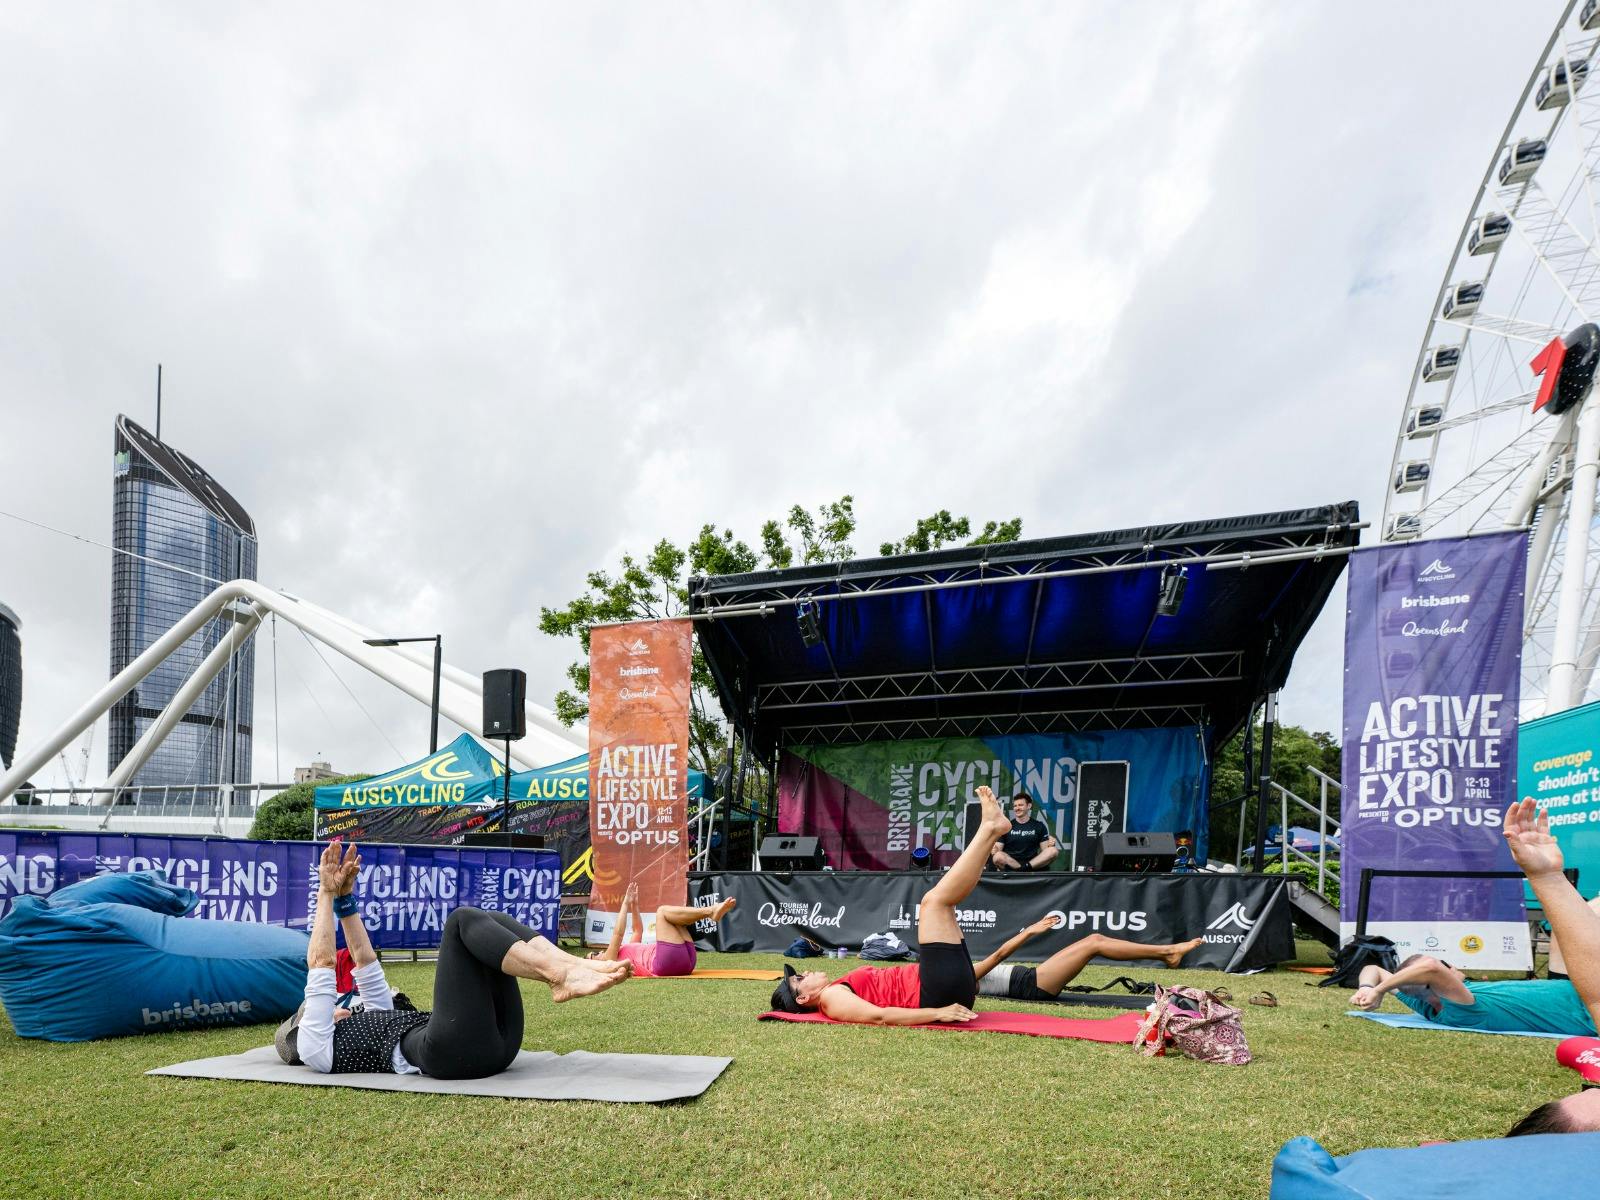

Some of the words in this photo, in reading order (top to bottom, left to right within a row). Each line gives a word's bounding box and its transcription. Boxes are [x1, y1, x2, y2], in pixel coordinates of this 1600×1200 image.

[1401, 594, 1471, 608] brisbane
[1401, 619, 1469, 637] Queensland
[620, 666, 659, 676] brisbane
[1361, 694, 1503, 743] ACTIVE
[597, 743, 678, 778] ACTIVE
[1360, 738, 1501, 774] LIFESTYLE
[1533, 750, 1593, 772] coverage
[526, 778, 587, 798] AUSC
[597, 777, 678, 802] LIFESTYLE
[918, 757, 1077, 806] CYCLING
[1359, 768, 1453, 810] EXPO
[1464, 777, 1490, 788] 12-13
[1537, 767, 1600, 791] shouldn't
[341, 782, 465, 806] AUSCYCLING
[1464, 788, 1492, 799] APRIL
[1536, 795, 1570, 809] come
[1572, 789, 1588, 804] at
[419, 805, 442, 817] TRACK
[597, 802, 649, 830] EXPO
[887, 763, 914, 851] BRISBANE
[1088, 800, 1099, 819] Red
[1395, 807, 1502, 828] OPTUS
[466, 815, 484, 828] MTB
[656, 815, 674, 823] APRIL
[1087, 819, 1098, 837] Bull
[1546, 811, 1587, 827] pense
[615, 830, 680, 845] OPTUS
[357, 865, 456, 899] YCLING
[757, 902, 845, 928] Queensland
[1048, 910, 1147, 931] OPTUS
[142, 999, 252, 1026] brisbane
